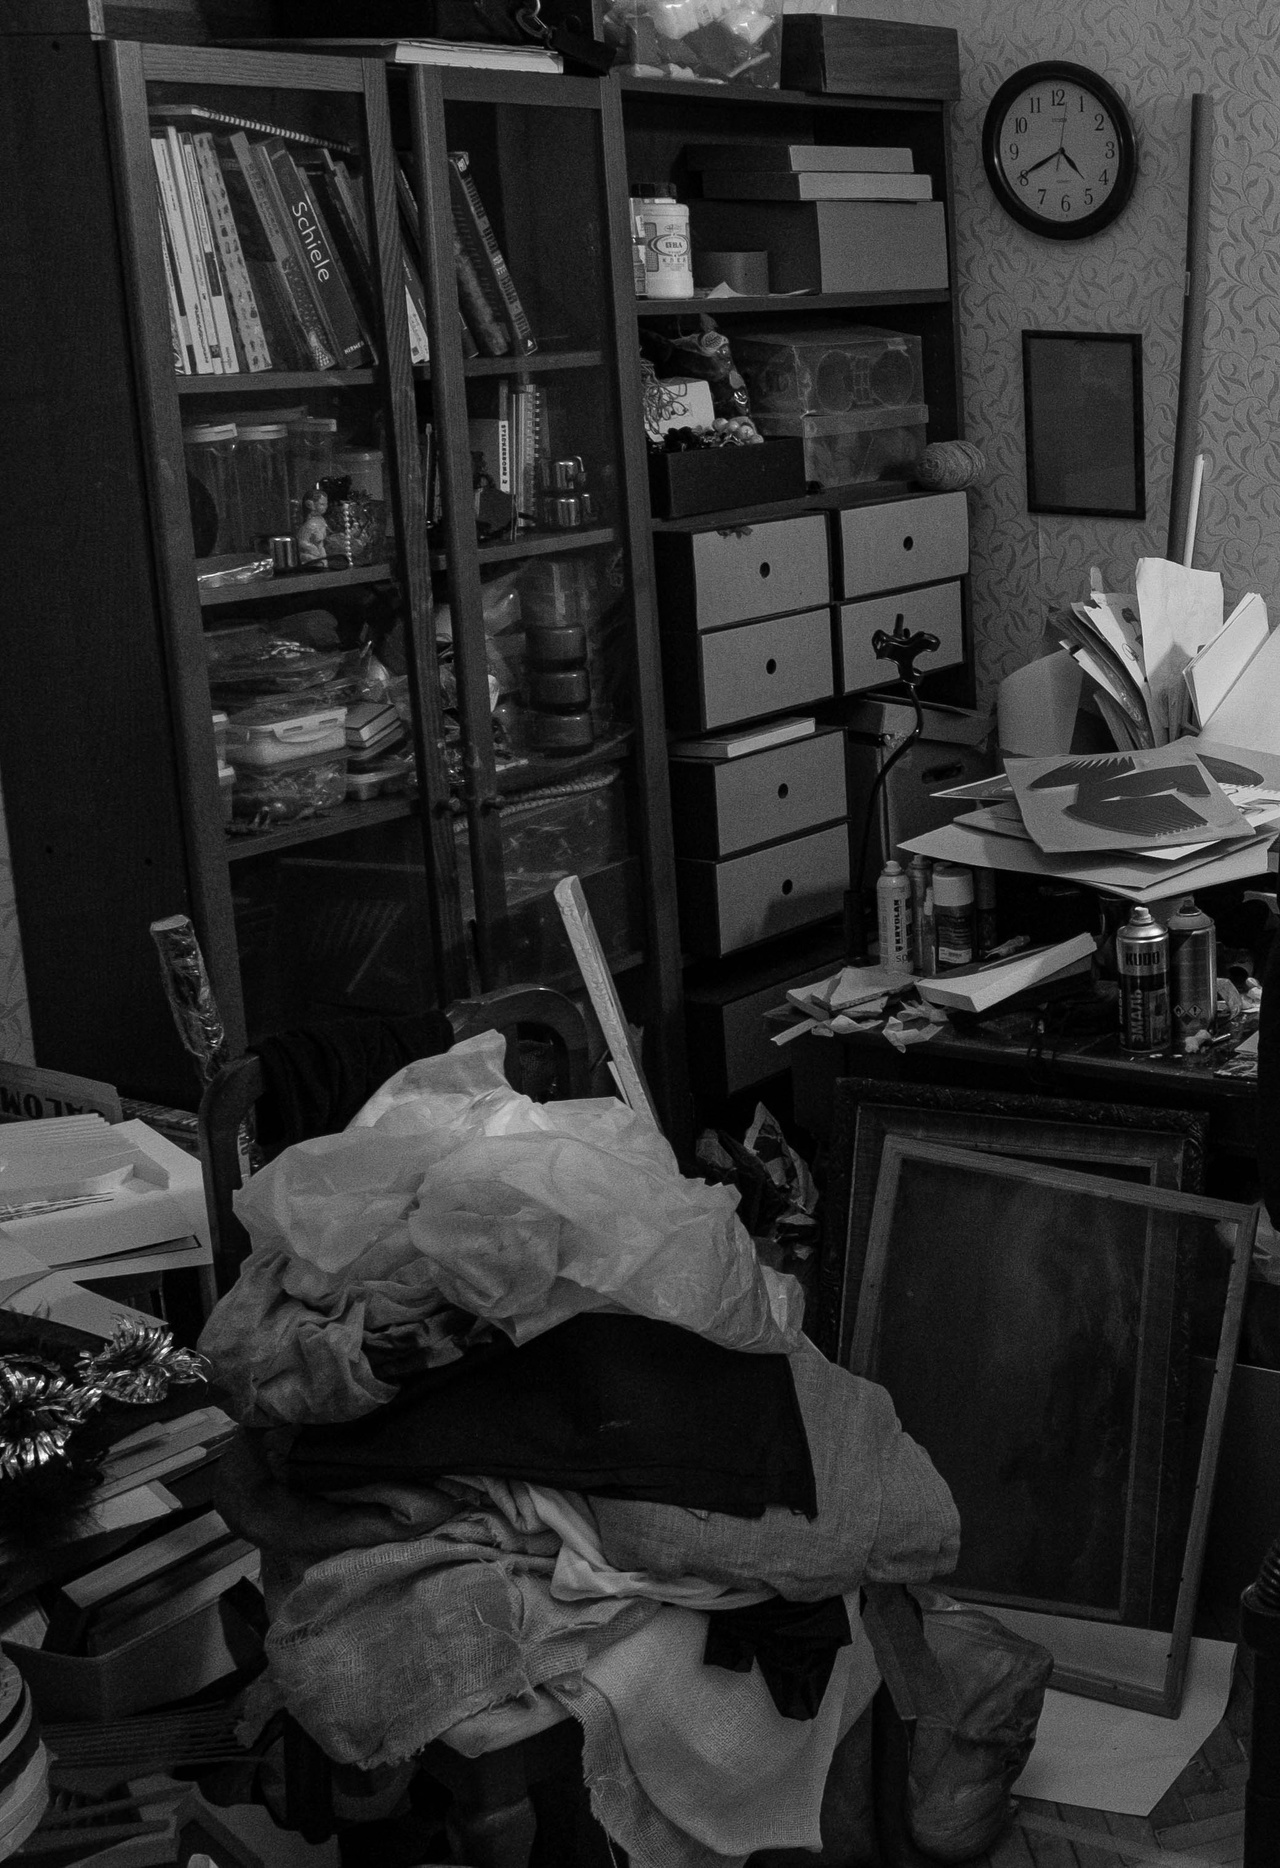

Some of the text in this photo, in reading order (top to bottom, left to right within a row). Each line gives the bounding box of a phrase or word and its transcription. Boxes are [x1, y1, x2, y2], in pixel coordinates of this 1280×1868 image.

[1030, 97, 1041, 113] 11
[1050, 89, 1066, 106] 12
[1079, 96, 1084, 112] 1
[1015, 117, 1028, 134] 10
[1094, 114, 1104, 131] 2
[1009, 143, 1019, 160] 9
[1105, 141, 1115, 159] 3
[1019, 170, 1029, 186] 8
[1098, 169, 1108, 185] 4
[1038, 189, 1046, 205] 7
[1060, 194, 1070, 212] 6
[1084, 188, 1094, 205] 5
[292, 201, 330, 283] Schiele
[893, 899, 901, 945] KRYOLAN
[1125, 951, 1160, 967] KUDO
[1129, 988, 1144, 1044] ЭМАЛЬ
[0, 1087, 105, 1120] ALOM
